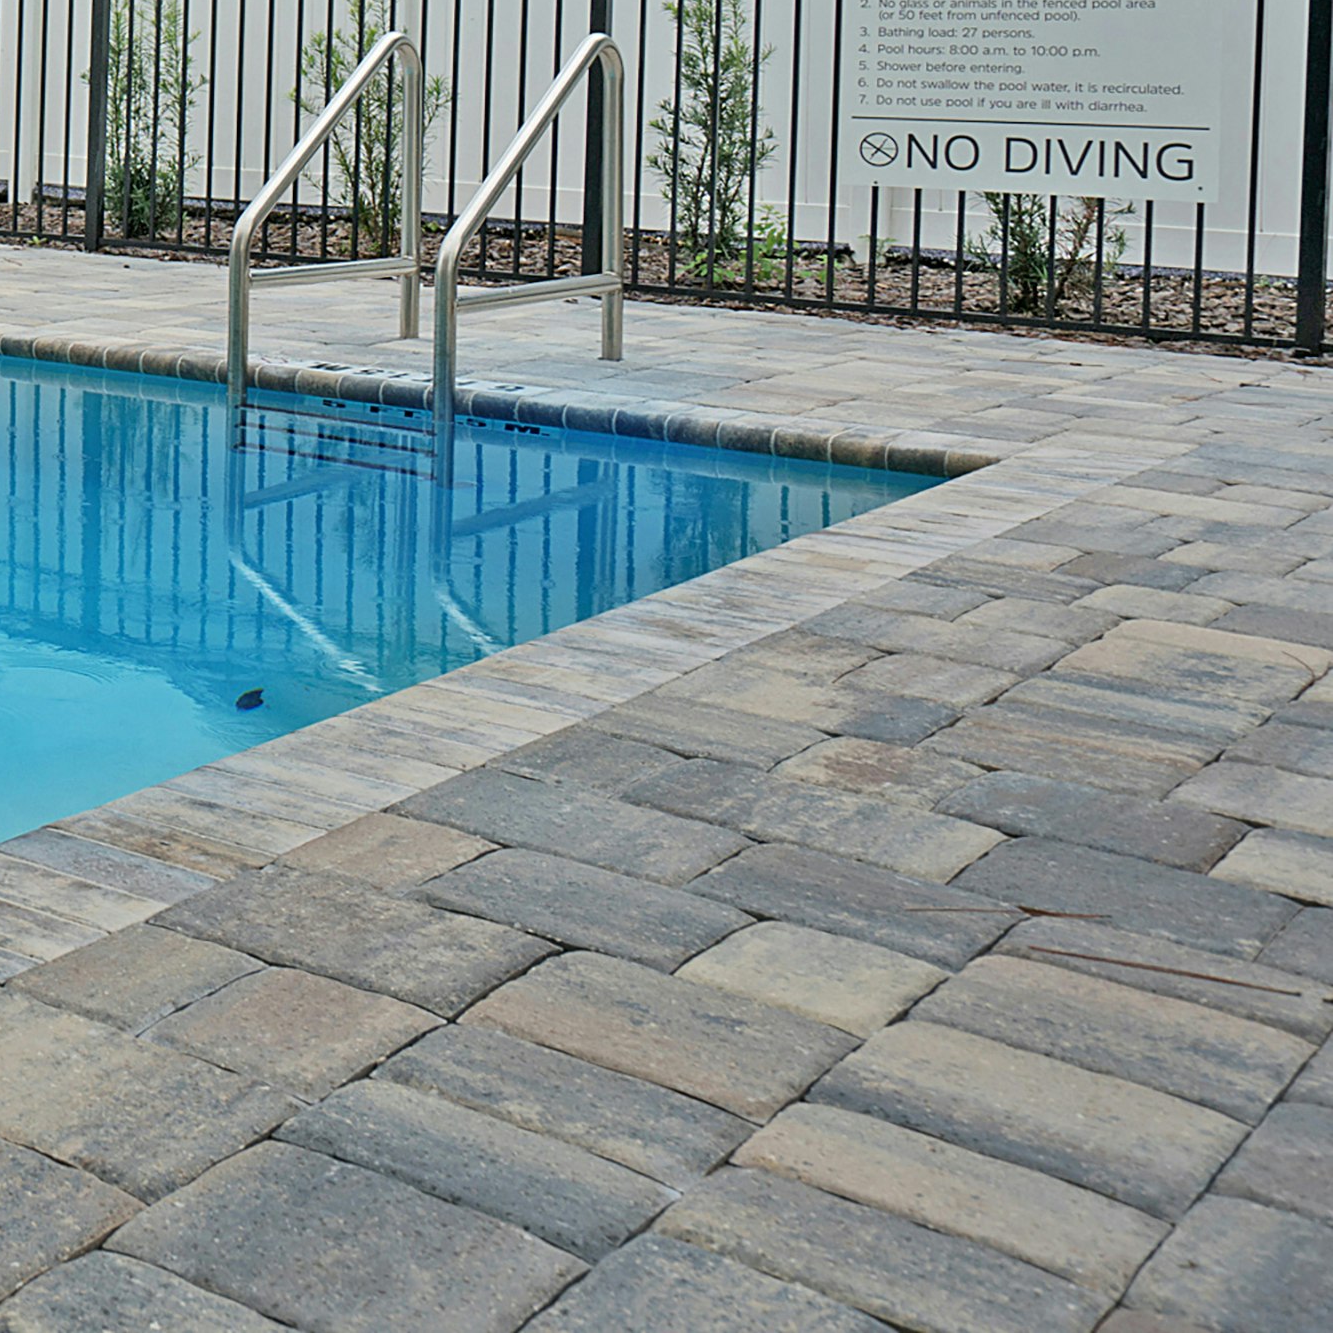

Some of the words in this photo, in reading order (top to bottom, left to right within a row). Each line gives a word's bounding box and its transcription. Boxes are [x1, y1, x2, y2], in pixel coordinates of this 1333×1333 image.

[879, 0, 896, 8] No
[899, 0, 929, 10] glass
[933, 0, 946, 8] or
[1001, 0, 1012, 8] in
[1017, 0, 1037, 9] the
[1092, 0, 1121, 10] pool
[1126, 0, 1155, 9] area
[878, 11, 894, 22] (or
[898, 11, 915, 21] 50
[919, 11, 942, 21] feet
[947, 11, 976, 21] from
[980, 11, 1039, 21] unfenced
[1044, 11, 1080, 22] pool).
[859, 27, 870, 37] 3.
[878, 27, 924, 39] Bathing
[928, 27, 957, 37] load:
[962, 27, 977, 38] 27
[982, 29, 1035, 40] persons.
[858, 44, 870, 54] 4.
[877, 44, 904, 54] Pool
[908, 45, 945, 55] hours:
[949, 45, 978, 55] 8:00
[982, 46, 1008, 56] a.m.
[1013, 46, 1026, 56] to
[1031, 46, 1068, 57] 10:00
[1072, 48, 1100, 58] p.m.
[859, 61, 870, 70] 5.
[876, 61, 921, 71] Shower
[926, 61, 966, 72] before
[970, 63, 1025, 75] entering.
[858, 78, 869, 88] 6.
[876, 78, 893, 88] Do
[897, 79, 917, 89] not
[921, 79, 969, 89] swallow
[974, 80, 994, 90] the
[999, 81, 1026, 92] pool
[1031, 82, 1071, 93] water,
[1075, 82, 1083, 92] it
[1088, 83, 1098, 93] is
[1102, 83, 1184, 95] recirculated.
[859, 95, 869, 104] 7.
[876, 95, 892, 105] Do
[896, 96, 916, 106] not
[920, 98, 942, 107] use
[946, 97, 973, 108] pool
[977, 97, 985, 107] if
[989, 100, 1012, 110] you
[1016, 100, 1037, 109] are
[1042, 100, 1050, 110] ill
[1056, 101, 1083, 110] with
[1088, 101, 1147, 113] diarrhea.
[906, 133, 979, 172] NO
[1004, 136, 1196, 182] DIVING
[322, 399, 346, 409] 5
